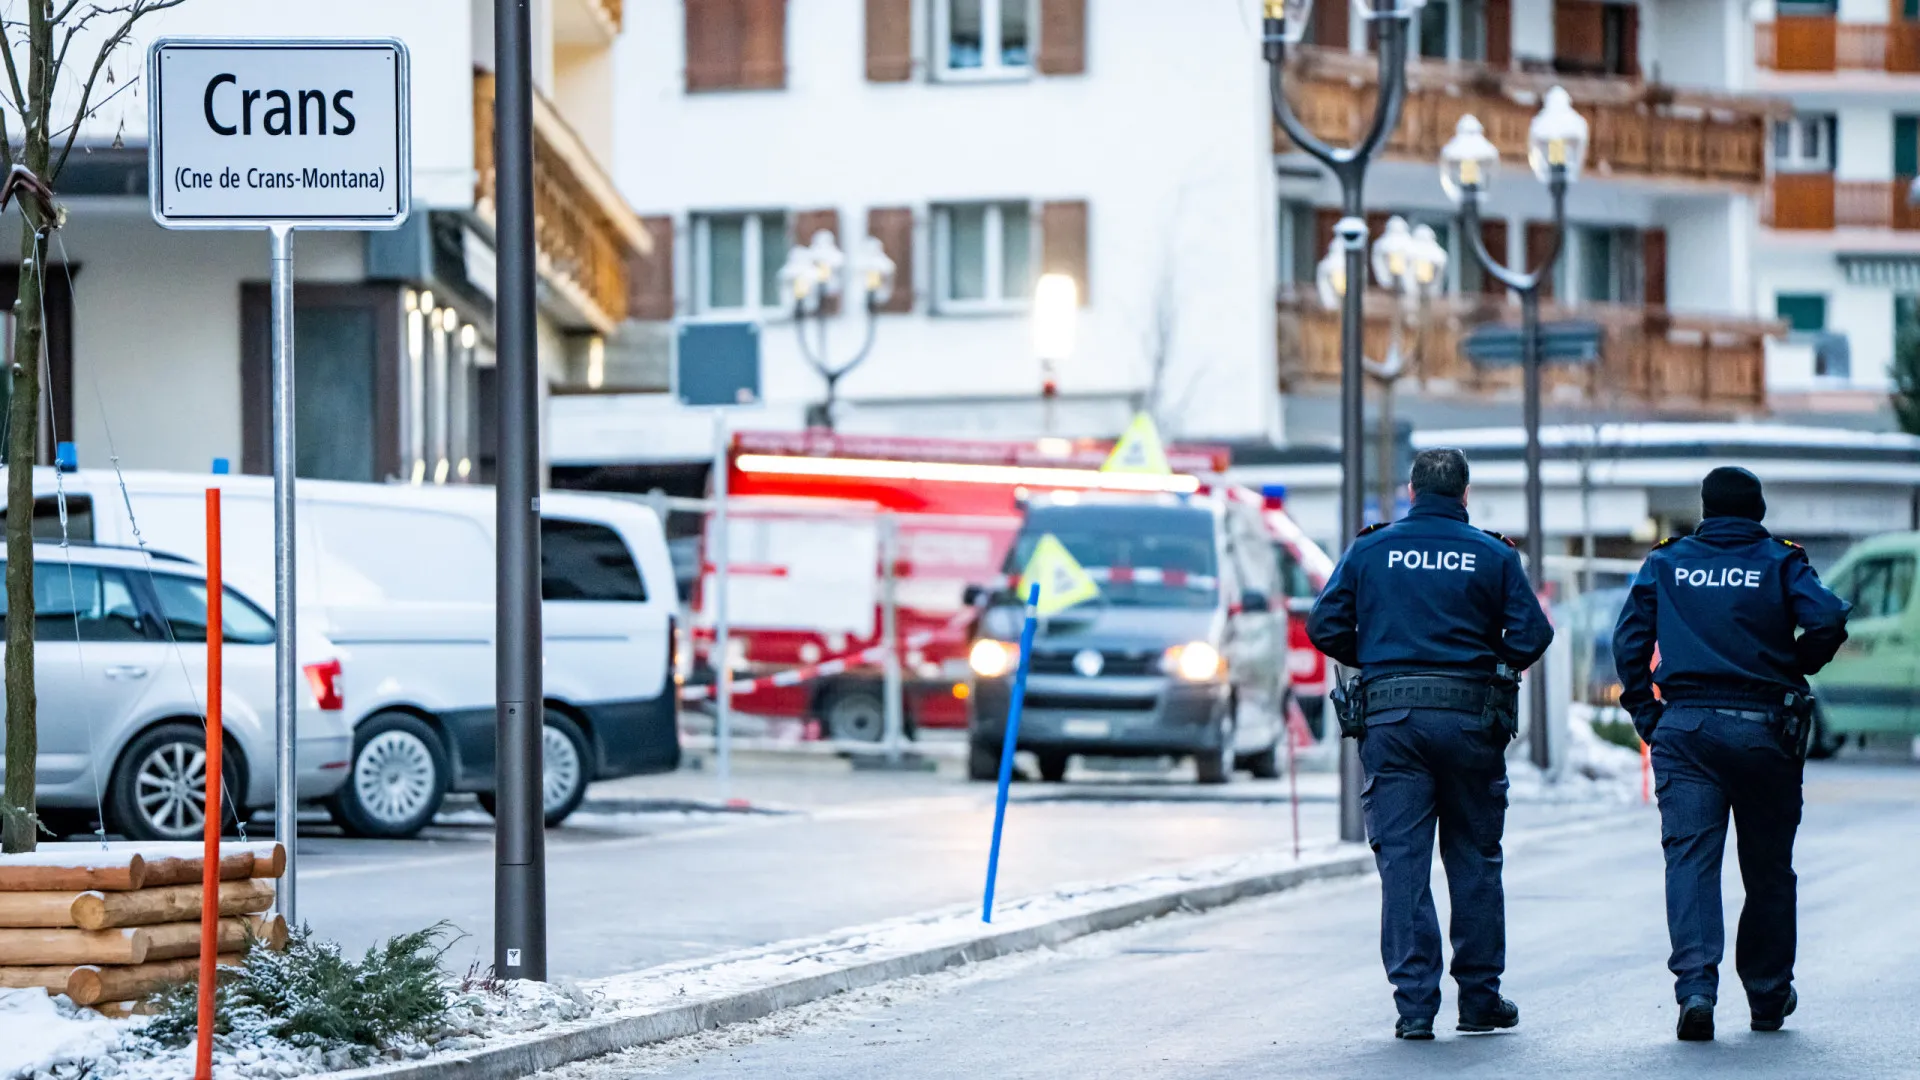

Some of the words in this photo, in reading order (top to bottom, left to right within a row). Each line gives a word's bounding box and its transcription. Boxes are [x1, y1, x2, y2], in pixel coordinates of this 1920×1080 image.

[203, 73, 356, 136] Crans
[175, 166, 213, 192] (Cne
[219, 166, 240, 189] de
[247, 166, 384, 192] Crans-Montana)
[1388, 550, 1476, 571] POLICE
[1675, 567, 1760, 588] POLICE
